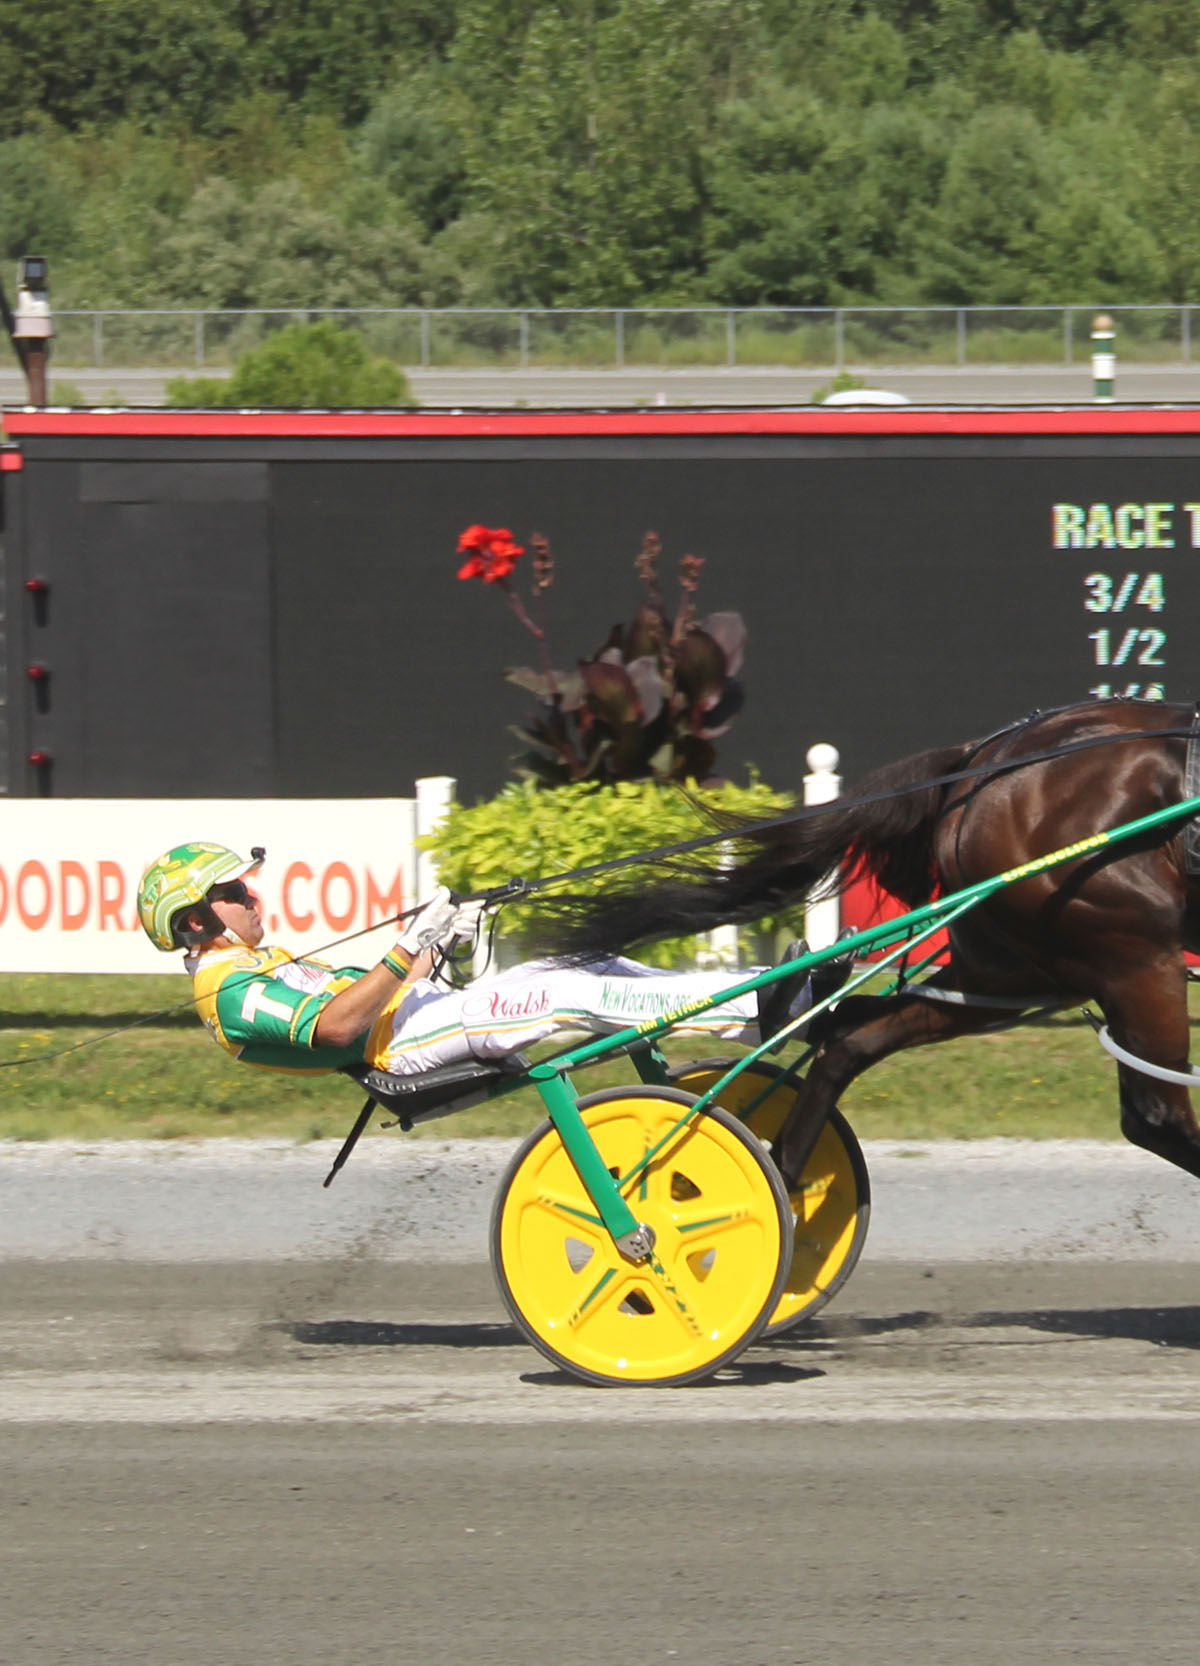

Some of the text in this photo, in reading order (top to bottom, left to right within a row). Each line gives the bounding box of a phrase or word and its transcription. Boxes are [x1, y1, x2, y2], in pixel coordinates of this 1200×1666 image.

[1052, 502, 1175, 549] RACE
[1084, 573, 1165, 613] 3/4
[1088, 628, 1167, 666] 1/2
[463, 989, 550, 1018] Walsh
[635, 1017, 658, 1035] TIM
